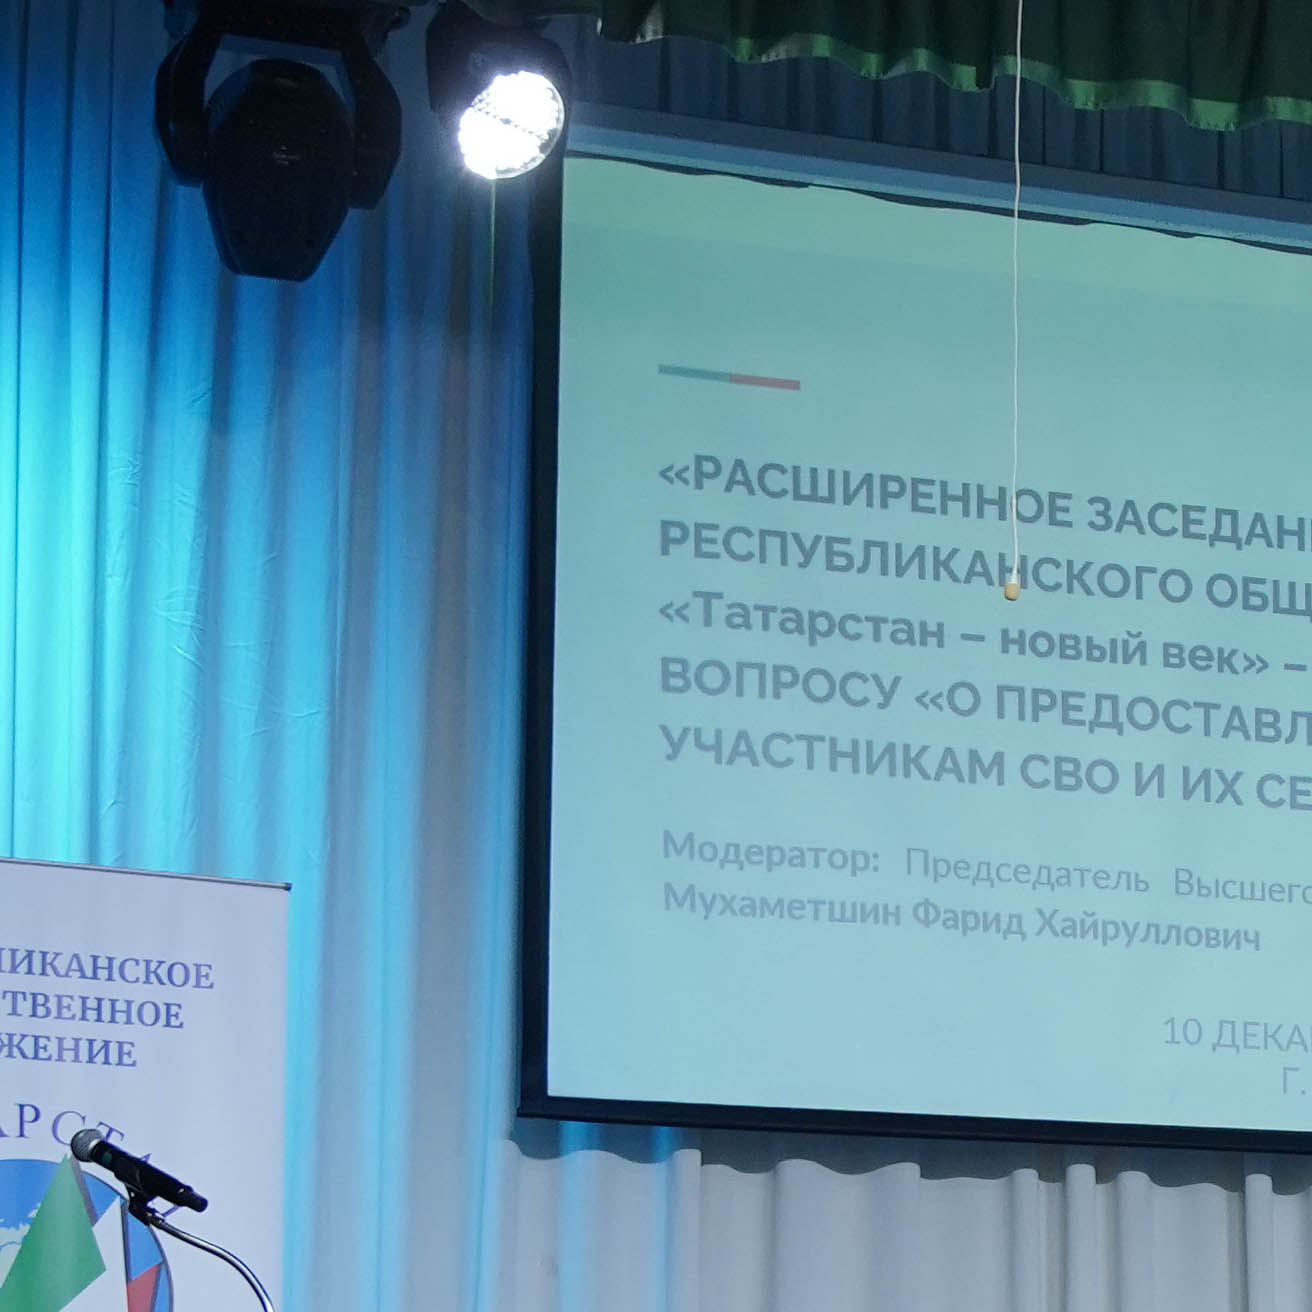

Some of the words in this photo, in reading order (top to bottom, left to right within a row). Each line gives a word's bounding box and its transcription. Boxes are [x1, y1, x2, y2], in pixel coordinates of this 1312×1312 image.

[659, 454, 1073, 529] «РАСШИРЕННОЕ
[660, 520, 1192, 602] РЕСПУБЛИКАНСКОГО
[659, 590, 945, 648] «Татарстан
[1000, 626, 1148, 668] новый
[1162, 642, 1269, 676] век»
[660, 657, 901, 710] ВОПРОСУ
[915, 682, 981, 717] «О
[659, 724, 1004, 787] УЧАСТНИКАМ
[1020, 752, 1119, 793] СВО
[1134, 764, 1164, 799] И
[1182, 767, 1243, 806] ИХ
[663, 831, 881, 873] Модератор:
[906, 848, 1149, 893] Председатель
[664, 882, 901, 927] Мухаметшин
[912, 899, 1025, 940] Фарид
[1036, 909, 1261, 951] Хайруллович
[0, 947, 215, 989] ИКАНСКОЕ
[1163, 1016, 1202, 1046] 10
[1282, 1067, 1307, 1096] Г.
